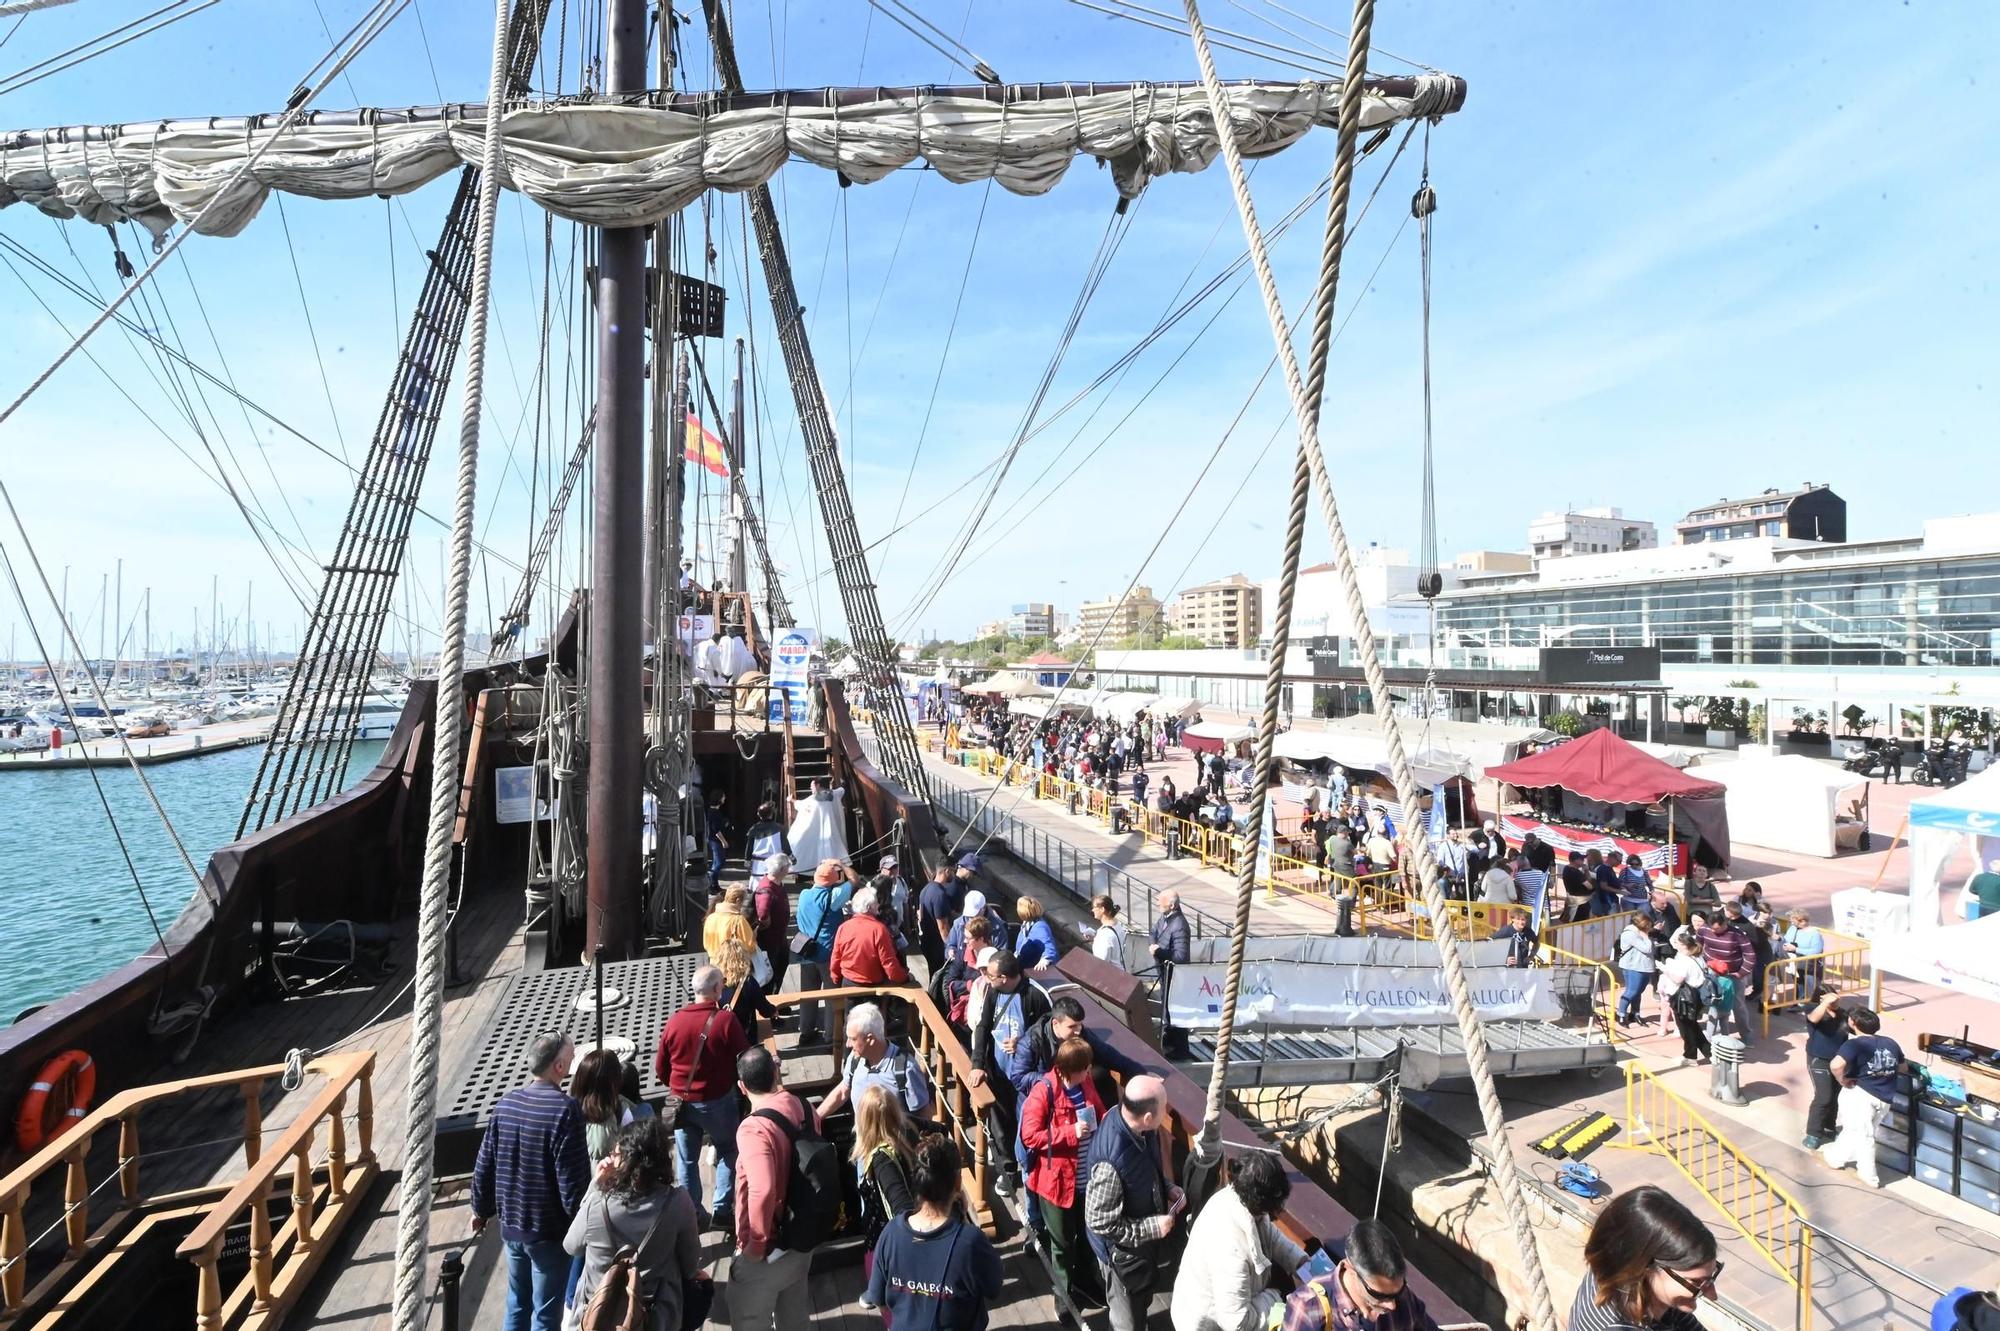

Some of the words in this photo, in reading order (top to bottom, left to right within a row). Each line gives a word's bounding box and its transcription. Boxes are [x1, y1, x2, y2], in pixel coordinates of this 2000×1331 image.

[1199, 975, 1279, 999] Anlucía
[1345, 989, 1361, 1007] EL
[1365, 985, 1431, 1007] GALEÓN
[1437, 986, 1528, 1006] AALUCÍA
[891, 1276, 904, 1287] EL
